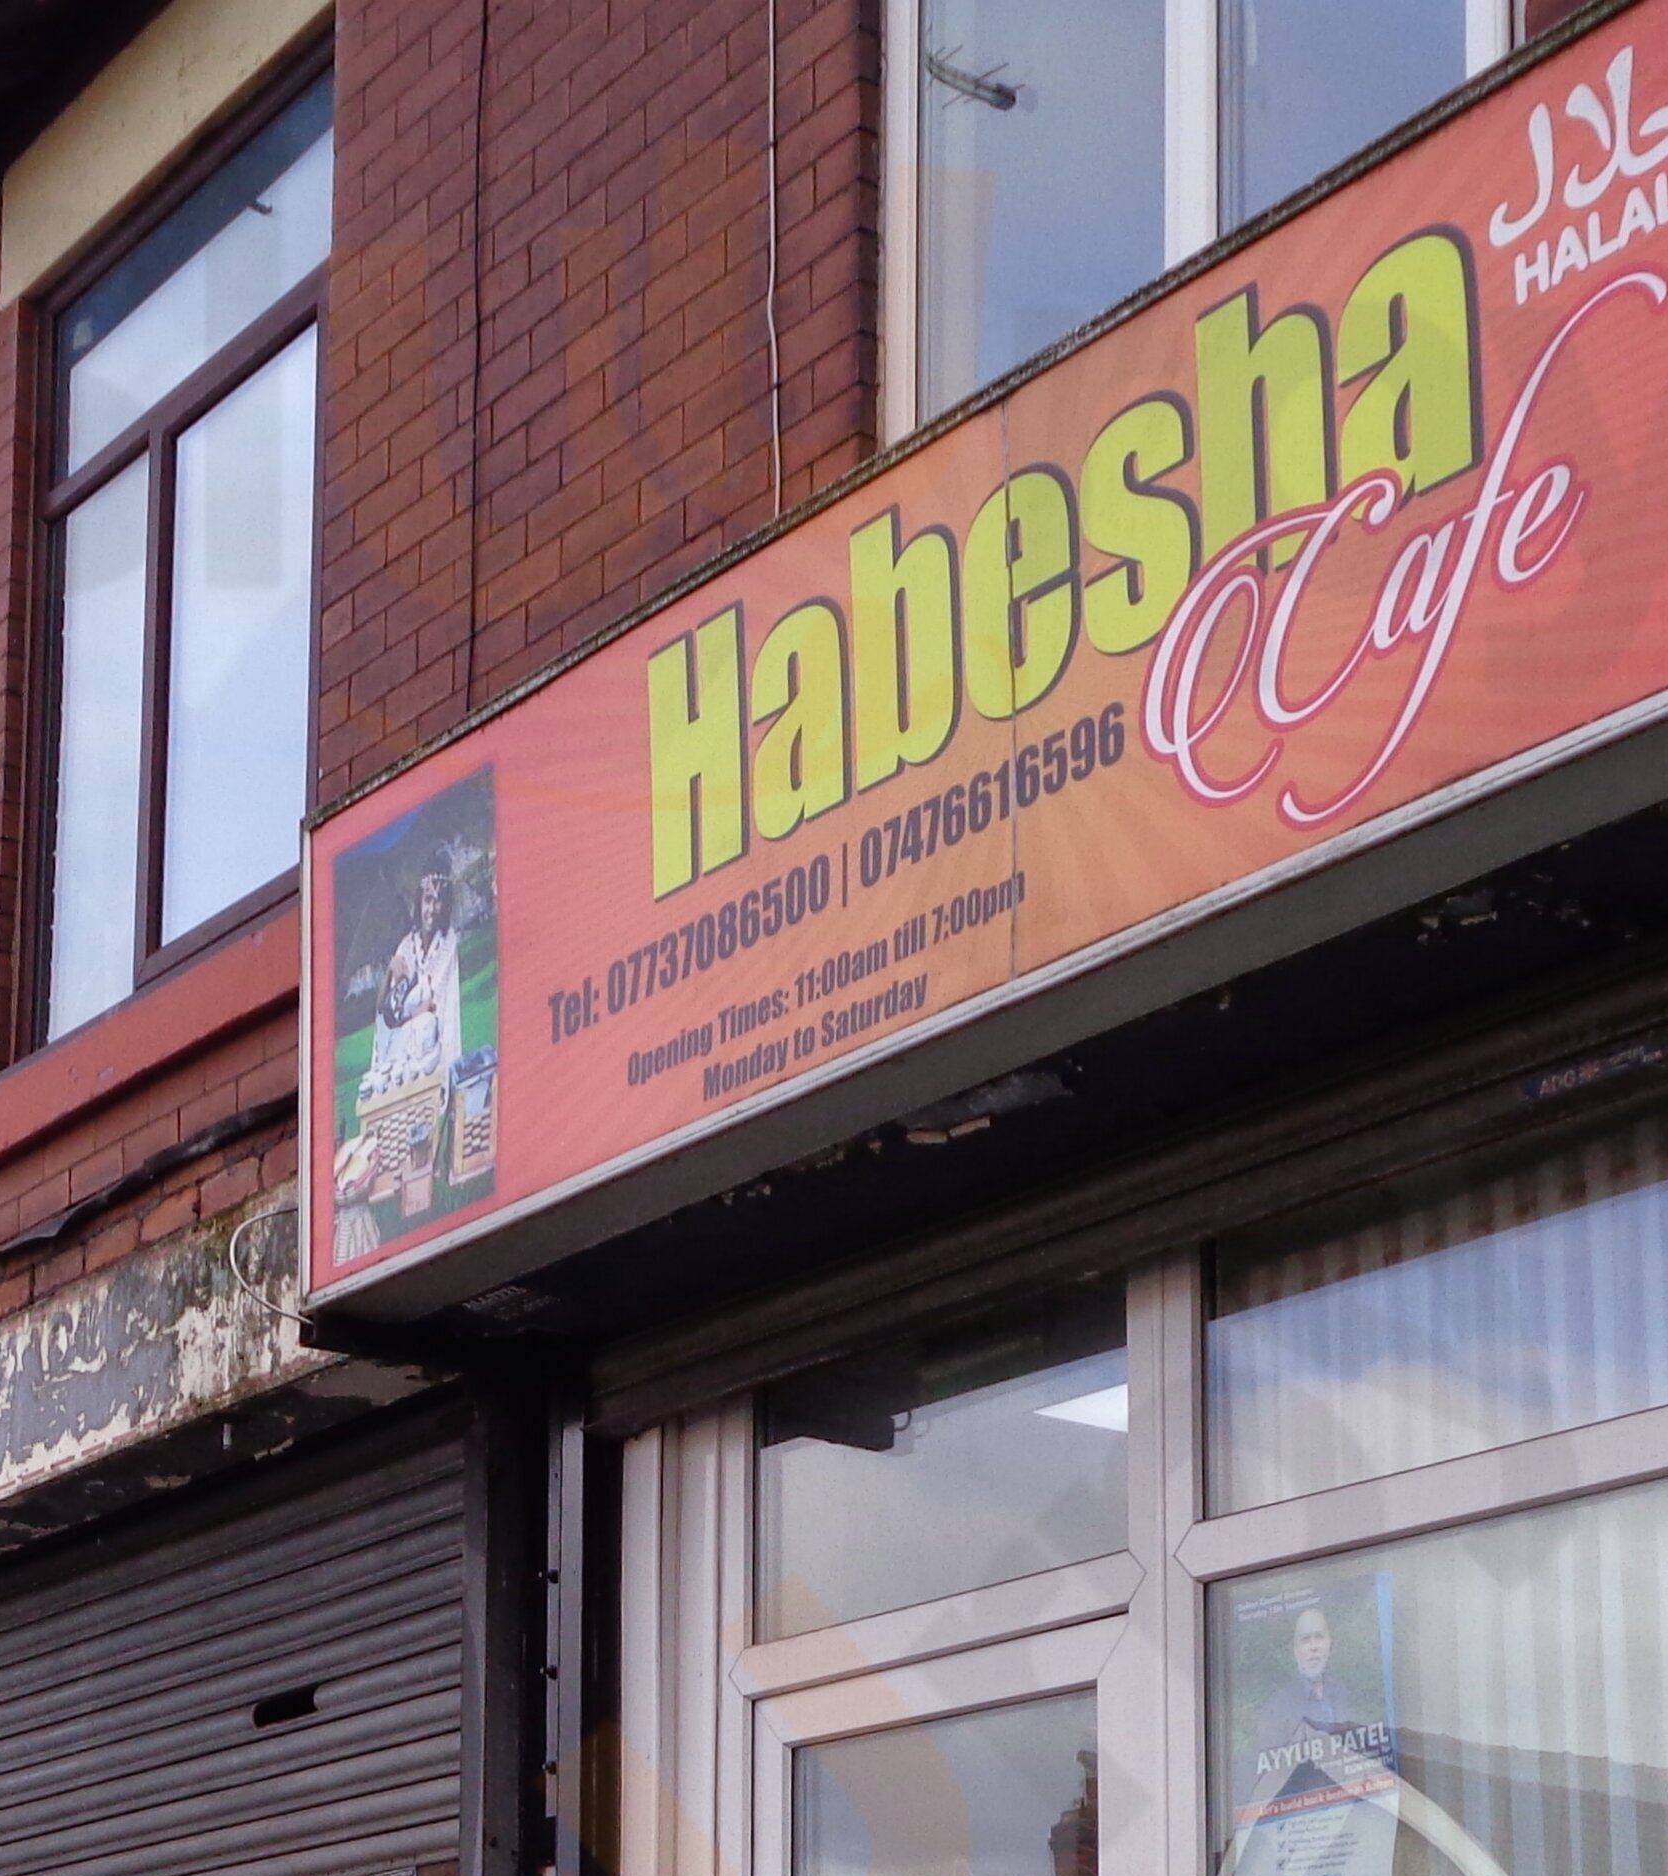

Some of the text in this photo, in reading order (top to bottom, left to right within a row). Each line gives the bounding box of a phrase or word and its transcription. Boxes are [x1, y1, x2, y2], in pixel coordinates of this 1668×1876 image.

[647, 224, 1483, 903] Habesha
[549, 976, 600, 1044] Tel:
[608, 854, 830, 1013] 07737086500
[860, 701, 1126, 887] 07476616596
[627, 871, 1025, 1086] Opening Times: 11:00am till 7:00pm
[702, 973, 928, 1101] Monday to Saturday
[1256, 1721, 1389, 1775] AYYUB PATEL
